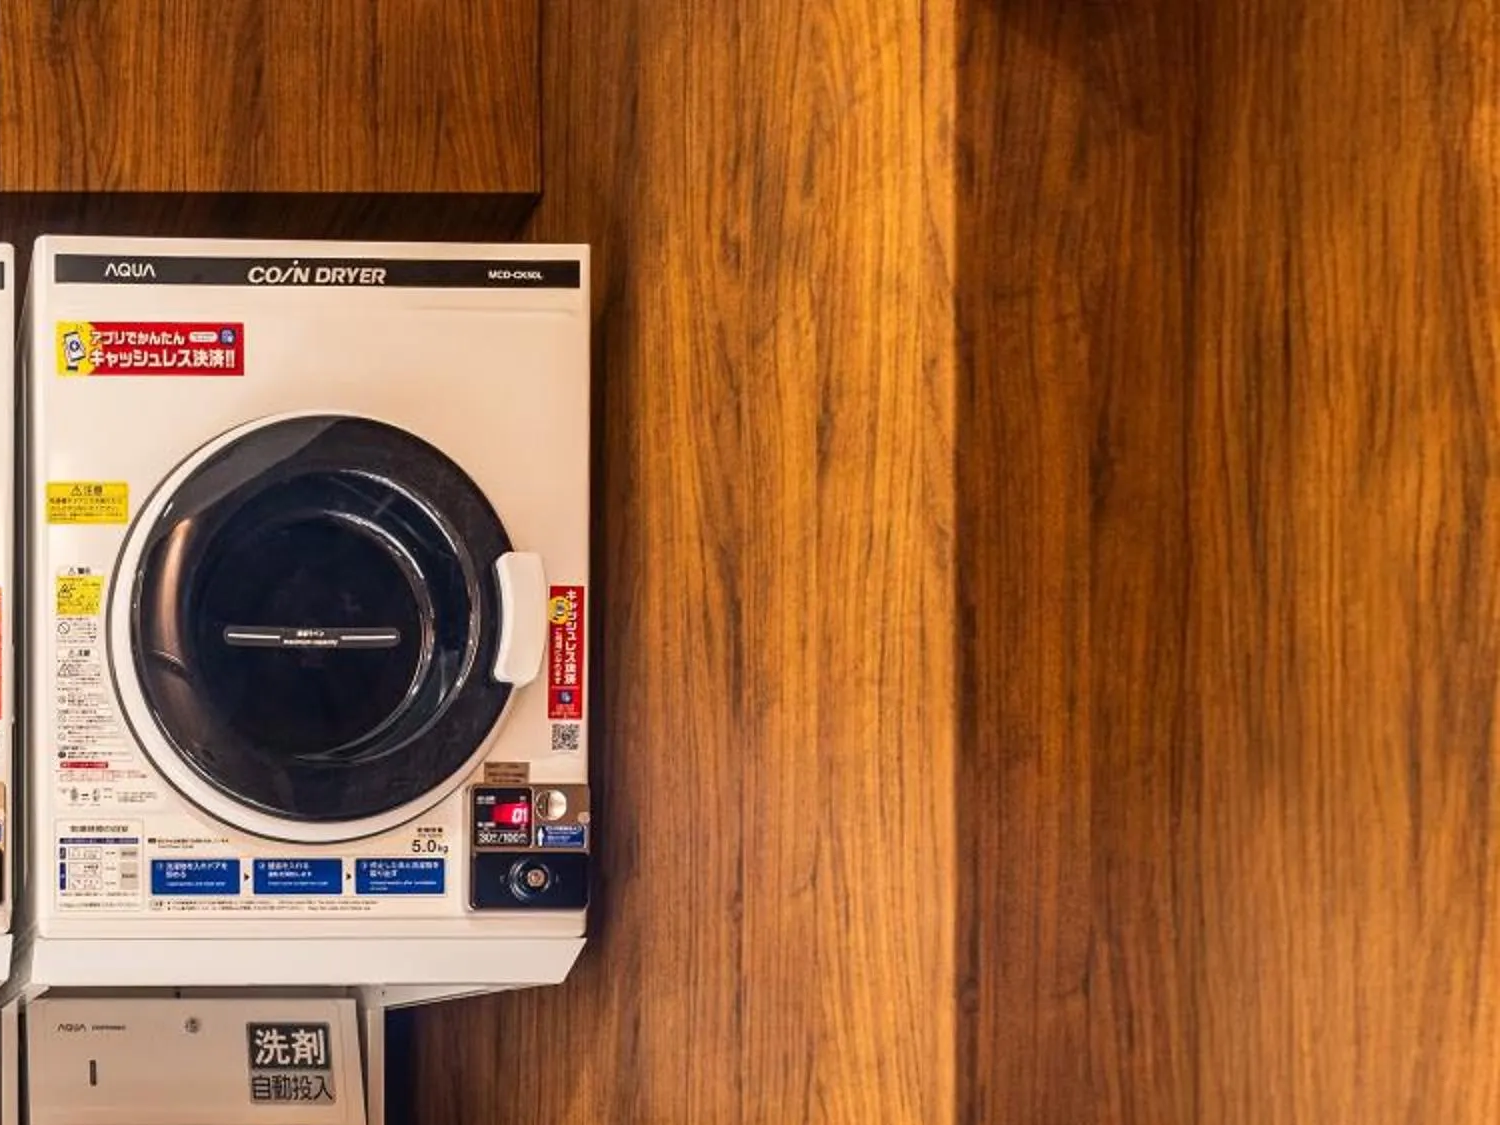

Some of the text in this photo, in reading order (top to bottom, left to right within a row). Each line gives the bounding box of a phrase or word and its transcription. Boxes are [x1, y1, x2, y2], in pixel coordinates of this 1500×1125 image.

[104, 263, 157, 278] AQUA
[247, 259, 387, 284] COIN DRYER
[90, 330, 185, 346] アプリでかんたん
[255, 1028, 325, 1065] 洗剤
[251, 1075, 333, 1101] 自動投入
